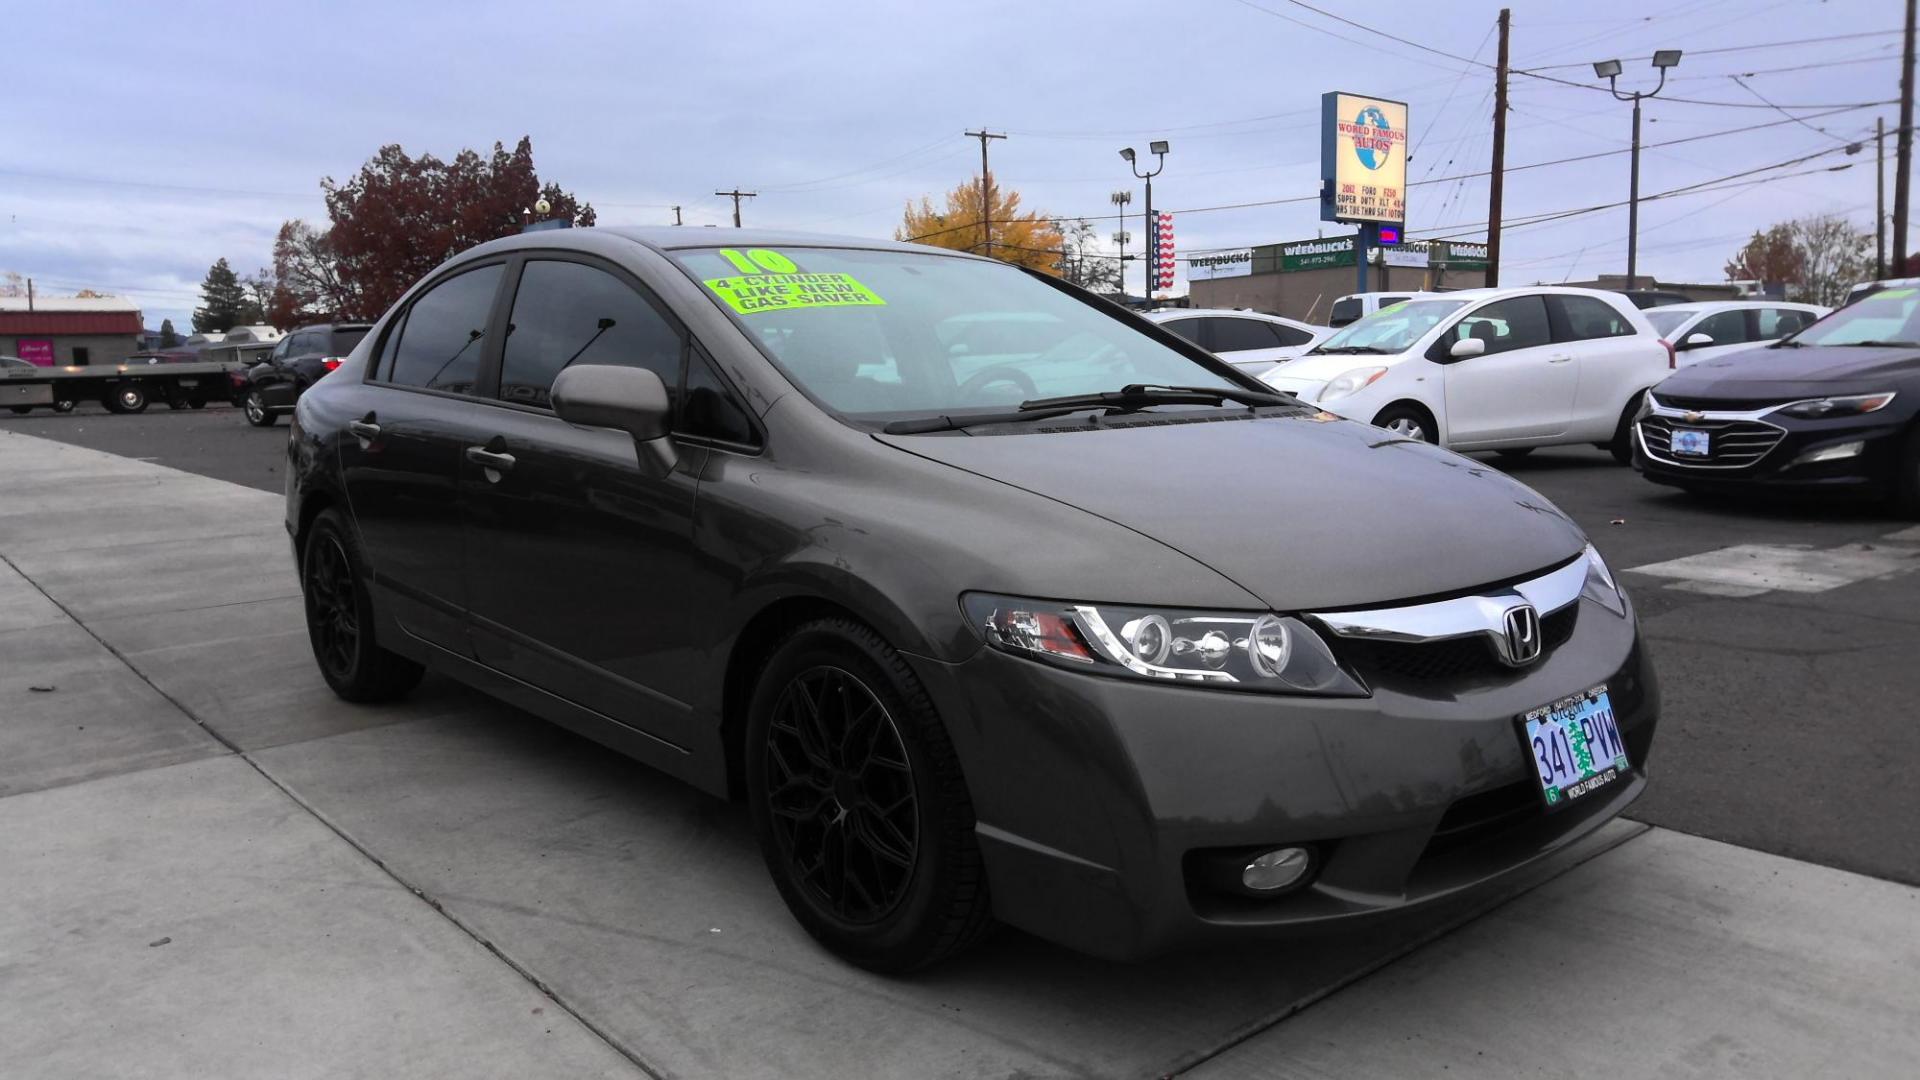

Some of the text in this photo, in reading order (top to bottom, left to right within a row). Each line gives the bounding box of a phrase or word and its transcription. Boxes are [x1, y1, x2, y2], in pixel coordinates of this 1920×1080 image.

[1338, 123, 1405, 141] WORLD FAMOUS
[1362, 185, 1377, 195] FORD
[1338, 194, 1356, 203] SUPER
[1361, 197, 1375, 206] DUTY
[1361, 206, 1376, 216] THRU
[1377, 207, 1387, 217] SAT
[720, 249, 798, 274] 10
[1189, 252, 1250, 268] WEEDBUCKS
[733, 283, 853, 299] LIKE NEW
[1533, 708, 1623, 785] 341 PVW
[1568, 769, 1616, 800] WORLD FAMOUS AUTO
